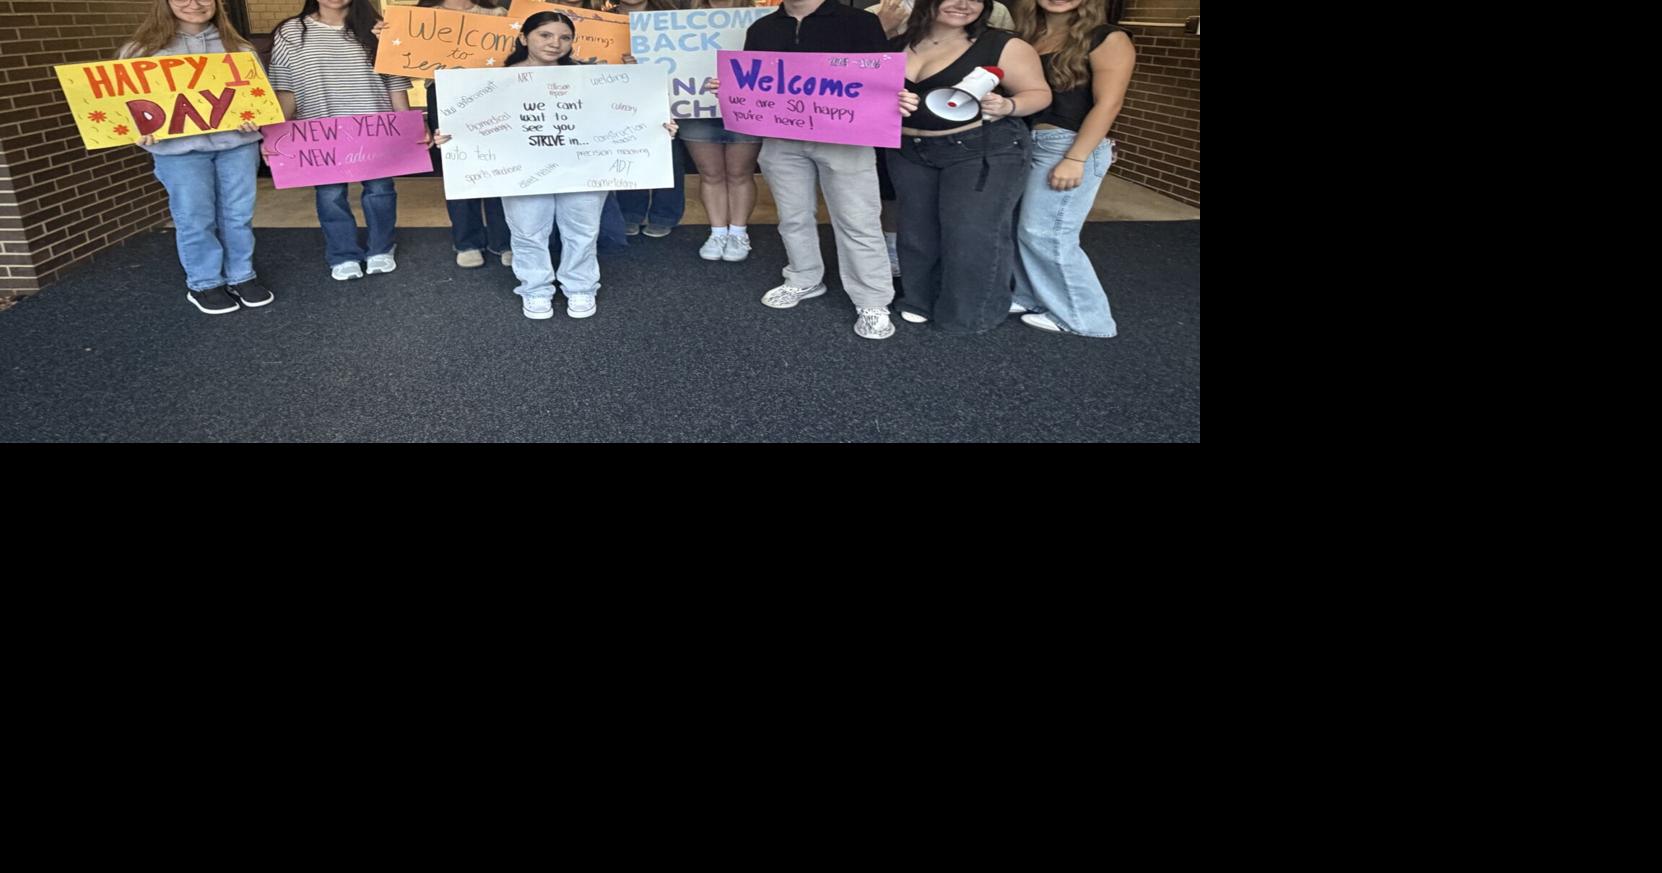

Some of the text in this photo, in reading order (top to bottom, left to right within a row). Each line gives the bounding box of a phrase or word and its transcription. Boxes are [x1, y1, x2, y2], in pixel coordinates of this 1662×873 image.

[408, 10, 515, 52] Welcom
[632, 32, 722, 54] BACK
[447, 47, 474, 60] to
[83, 56, 208, 99] HAPPY
[590, 72, 630, 86] welding
[730, 58, 864, 98] Welcome
[126, 87, 236, 136] DAY
[523, 102, 546, 112] we
[729, 95, 856, 123] we are SO happy
[520, 112, 569, 123] wait to
[291, 113, 400, 143] NEW YEAR
[521, 123, 576, 135] see you
[593, 123, 648, 143] construction
[528, 134, 566, 147] STRIVE
[299, 147, 336, 168] NEW
[445, 144, 497, 161] auto tech
[576, 149, 614, 160] precision
[608, 158, 634, 175] ADT
[464, 169, 492, 184] sports
